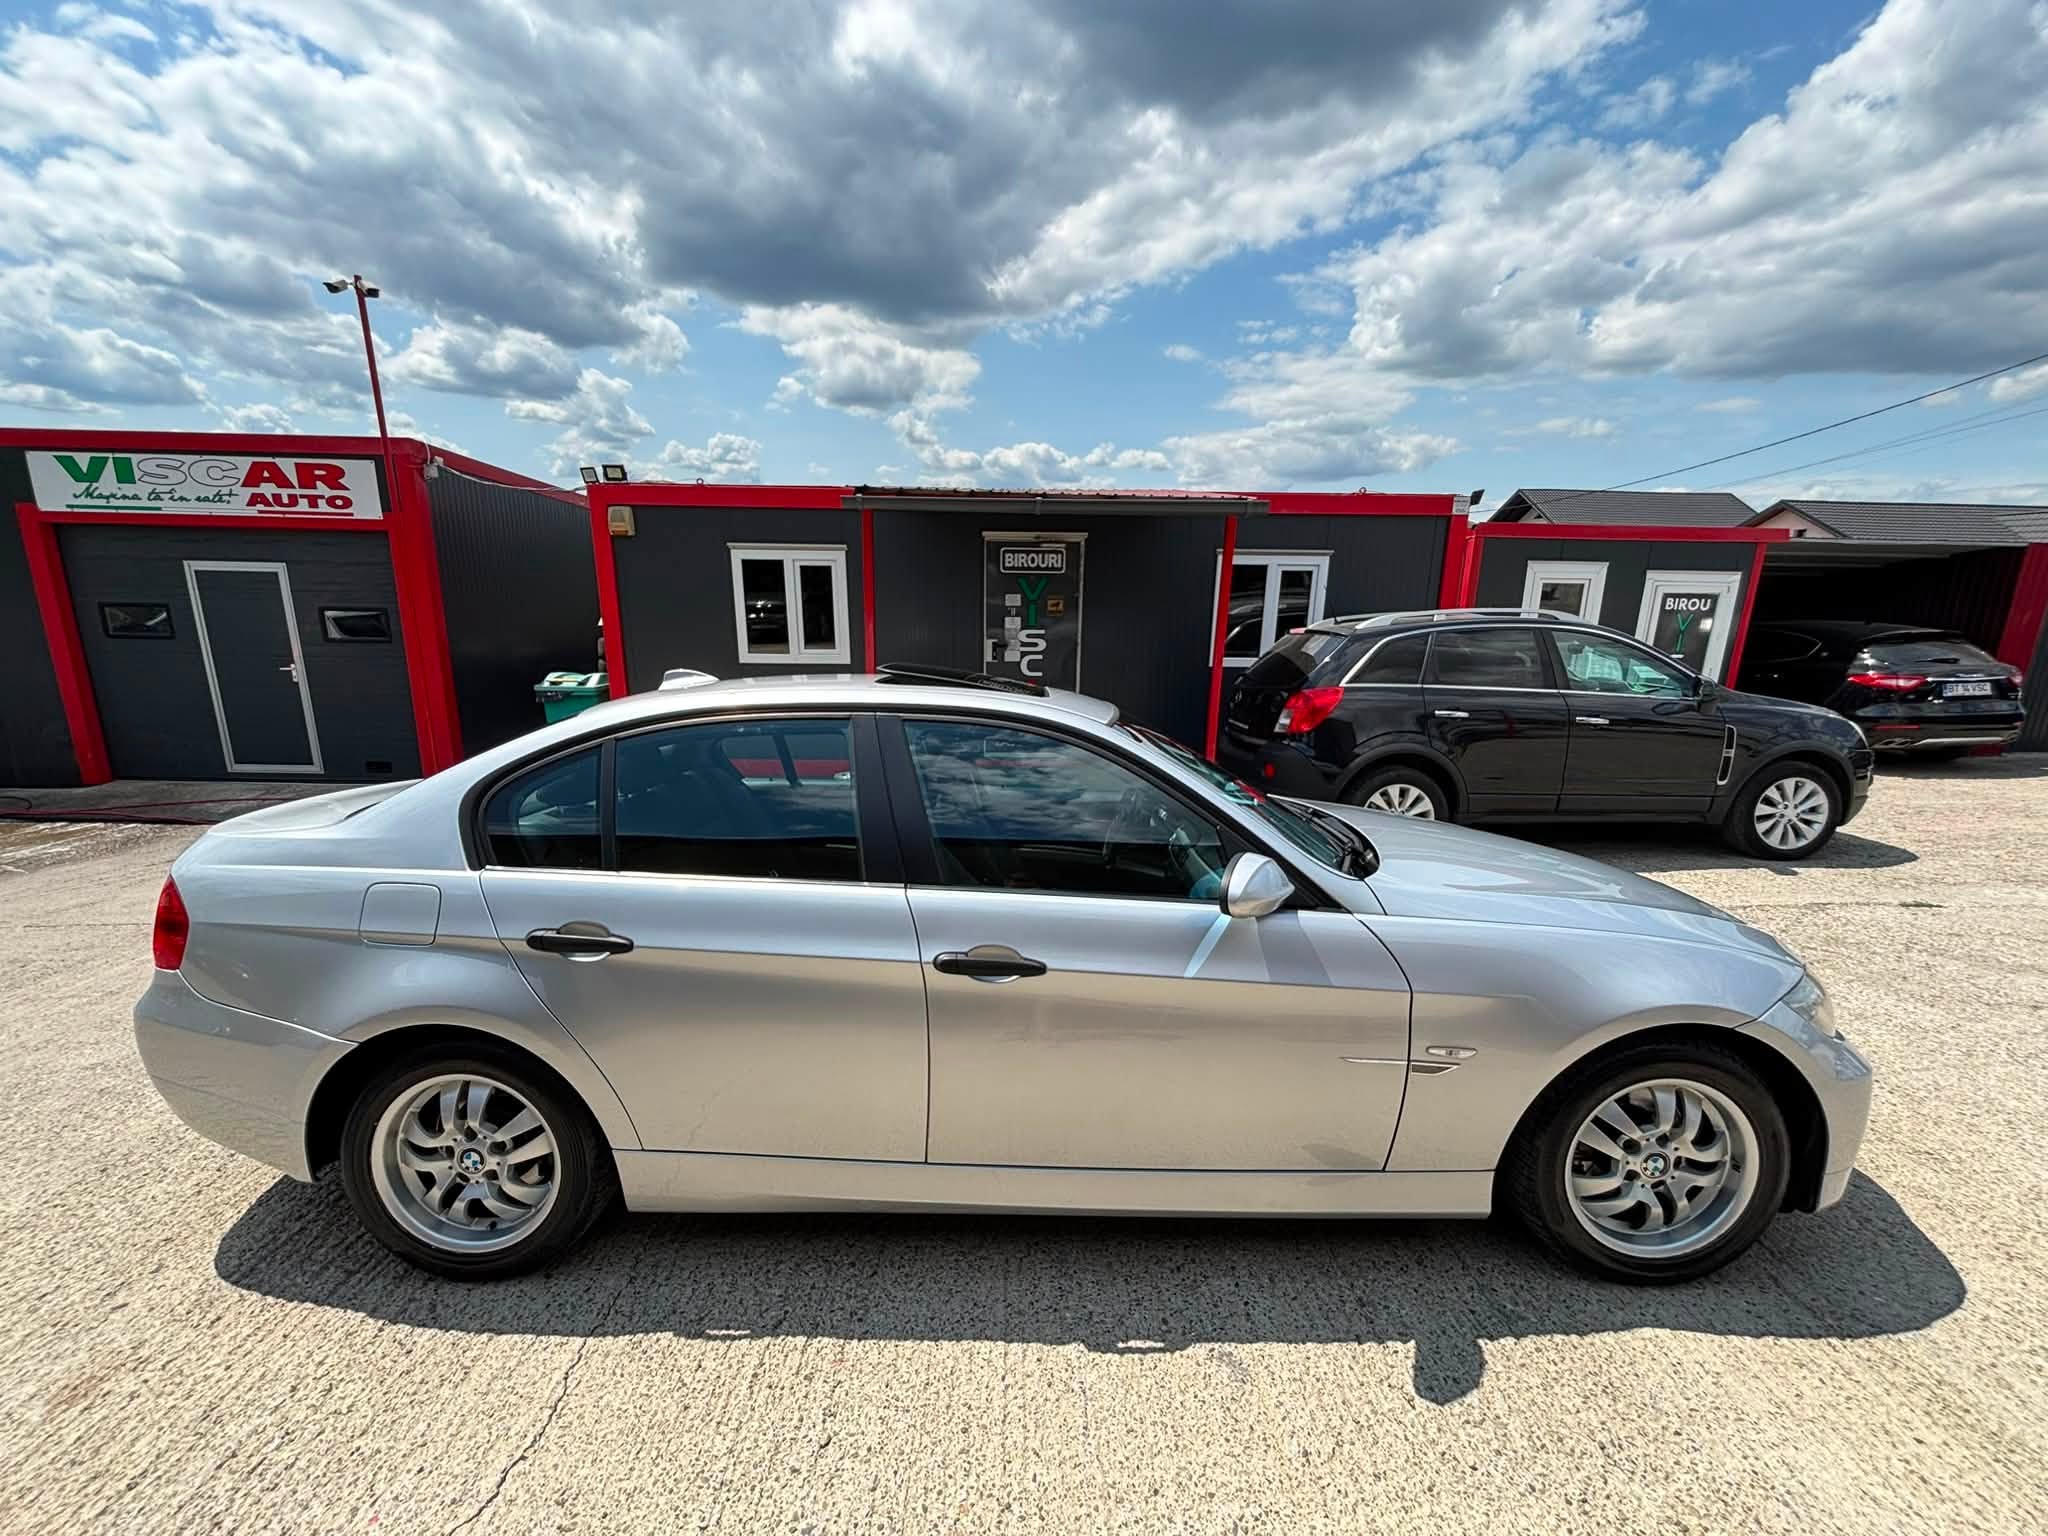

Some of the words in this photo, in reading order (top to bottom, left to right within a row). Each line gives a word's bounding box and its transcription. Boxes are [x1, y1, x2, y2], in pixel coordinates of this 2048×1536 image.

[53, 455, 351, 491] VISCAR
[246, 493, 353, 510] AUTO
[1004, 553, 1062, 568] BIROURI
[1664, 597, 1712, 611] BIROU
